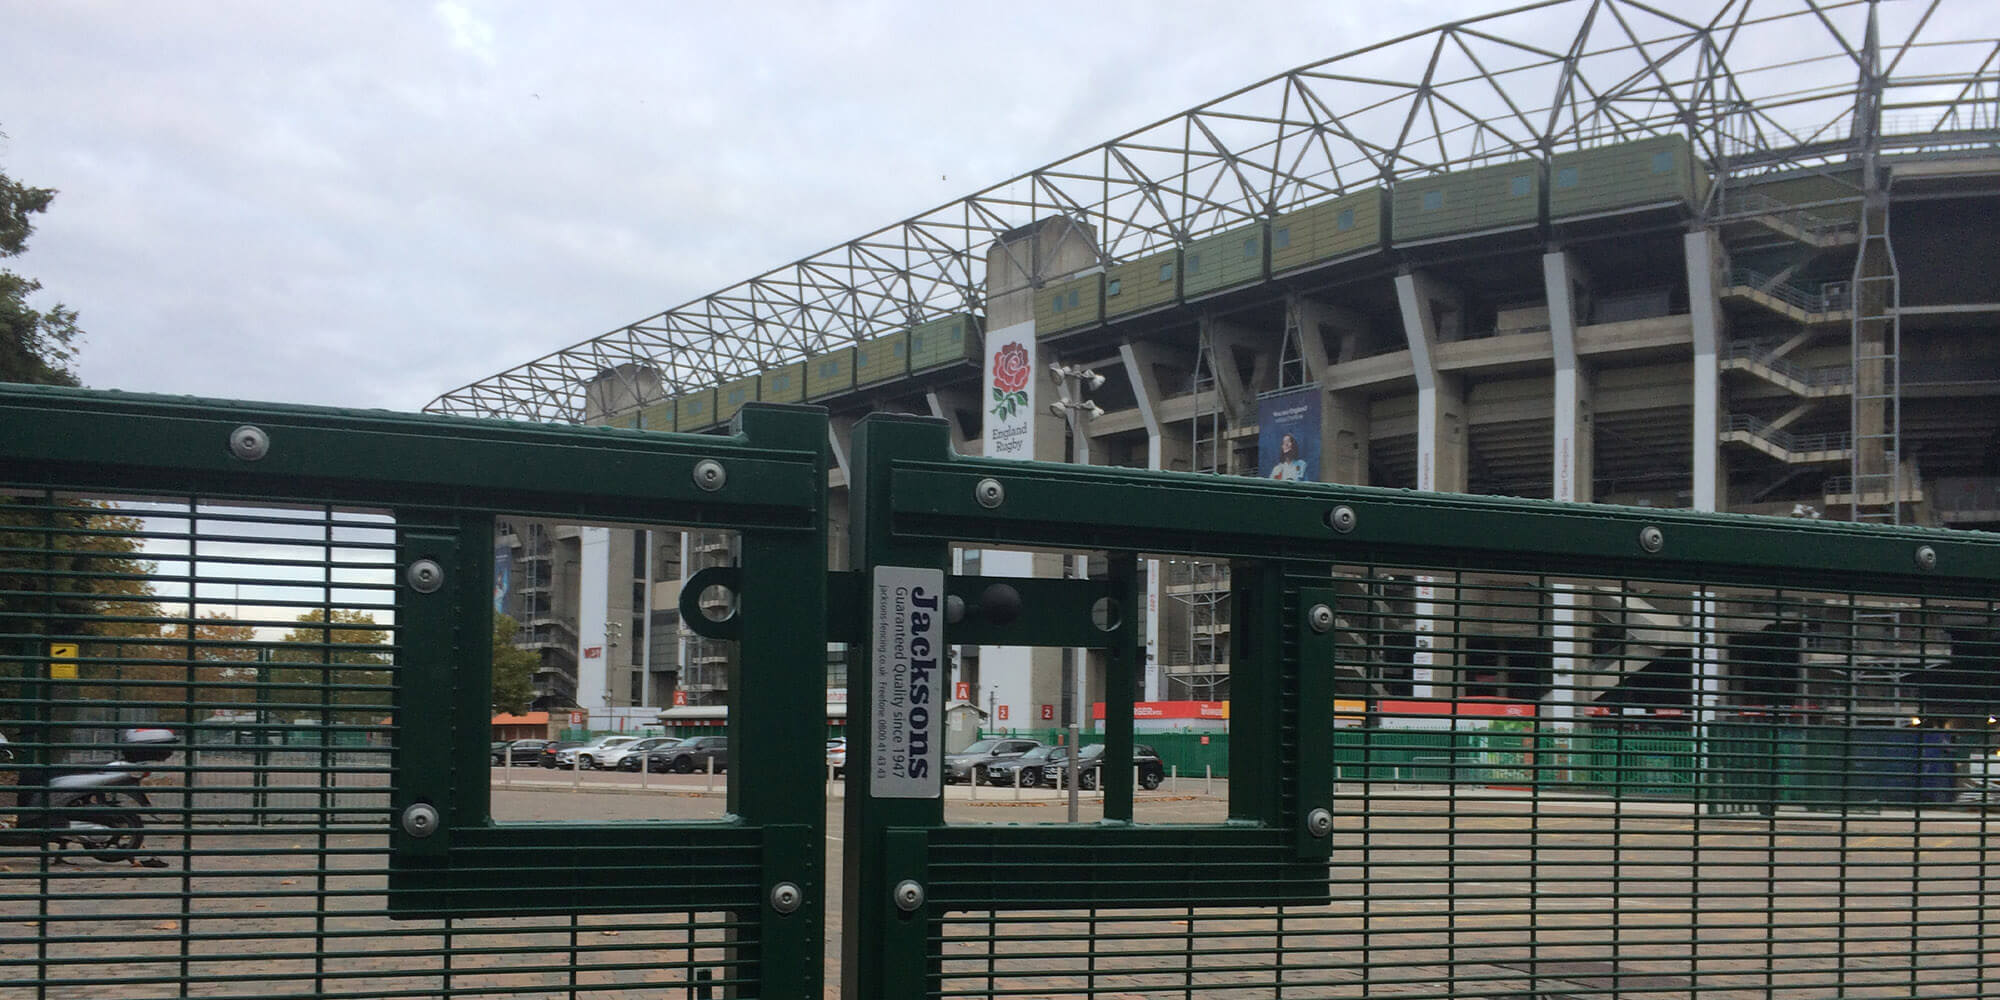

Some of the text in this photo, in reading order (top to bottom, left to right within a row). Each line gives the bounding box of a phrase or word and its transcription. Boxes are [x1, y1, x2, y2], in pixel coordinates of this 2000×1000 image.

[992, 422, 1027, 440] England
[996, 438, 1022, 453] Rugby
[585, 647, 602, 658] WEST
[890, 586, 908, 779] Guaranteed Quality since 1947
[908, 586, 938, 779] Jacksons
[878, 681, 888, 718] Freefone
[959, 687, 968, 699] A
[677, 697, 684, 705] A
[1000, 709, 1007, 718] 2
[1044, 708, 1051, 719] 2
[878, 719, 887, 741] 0800
